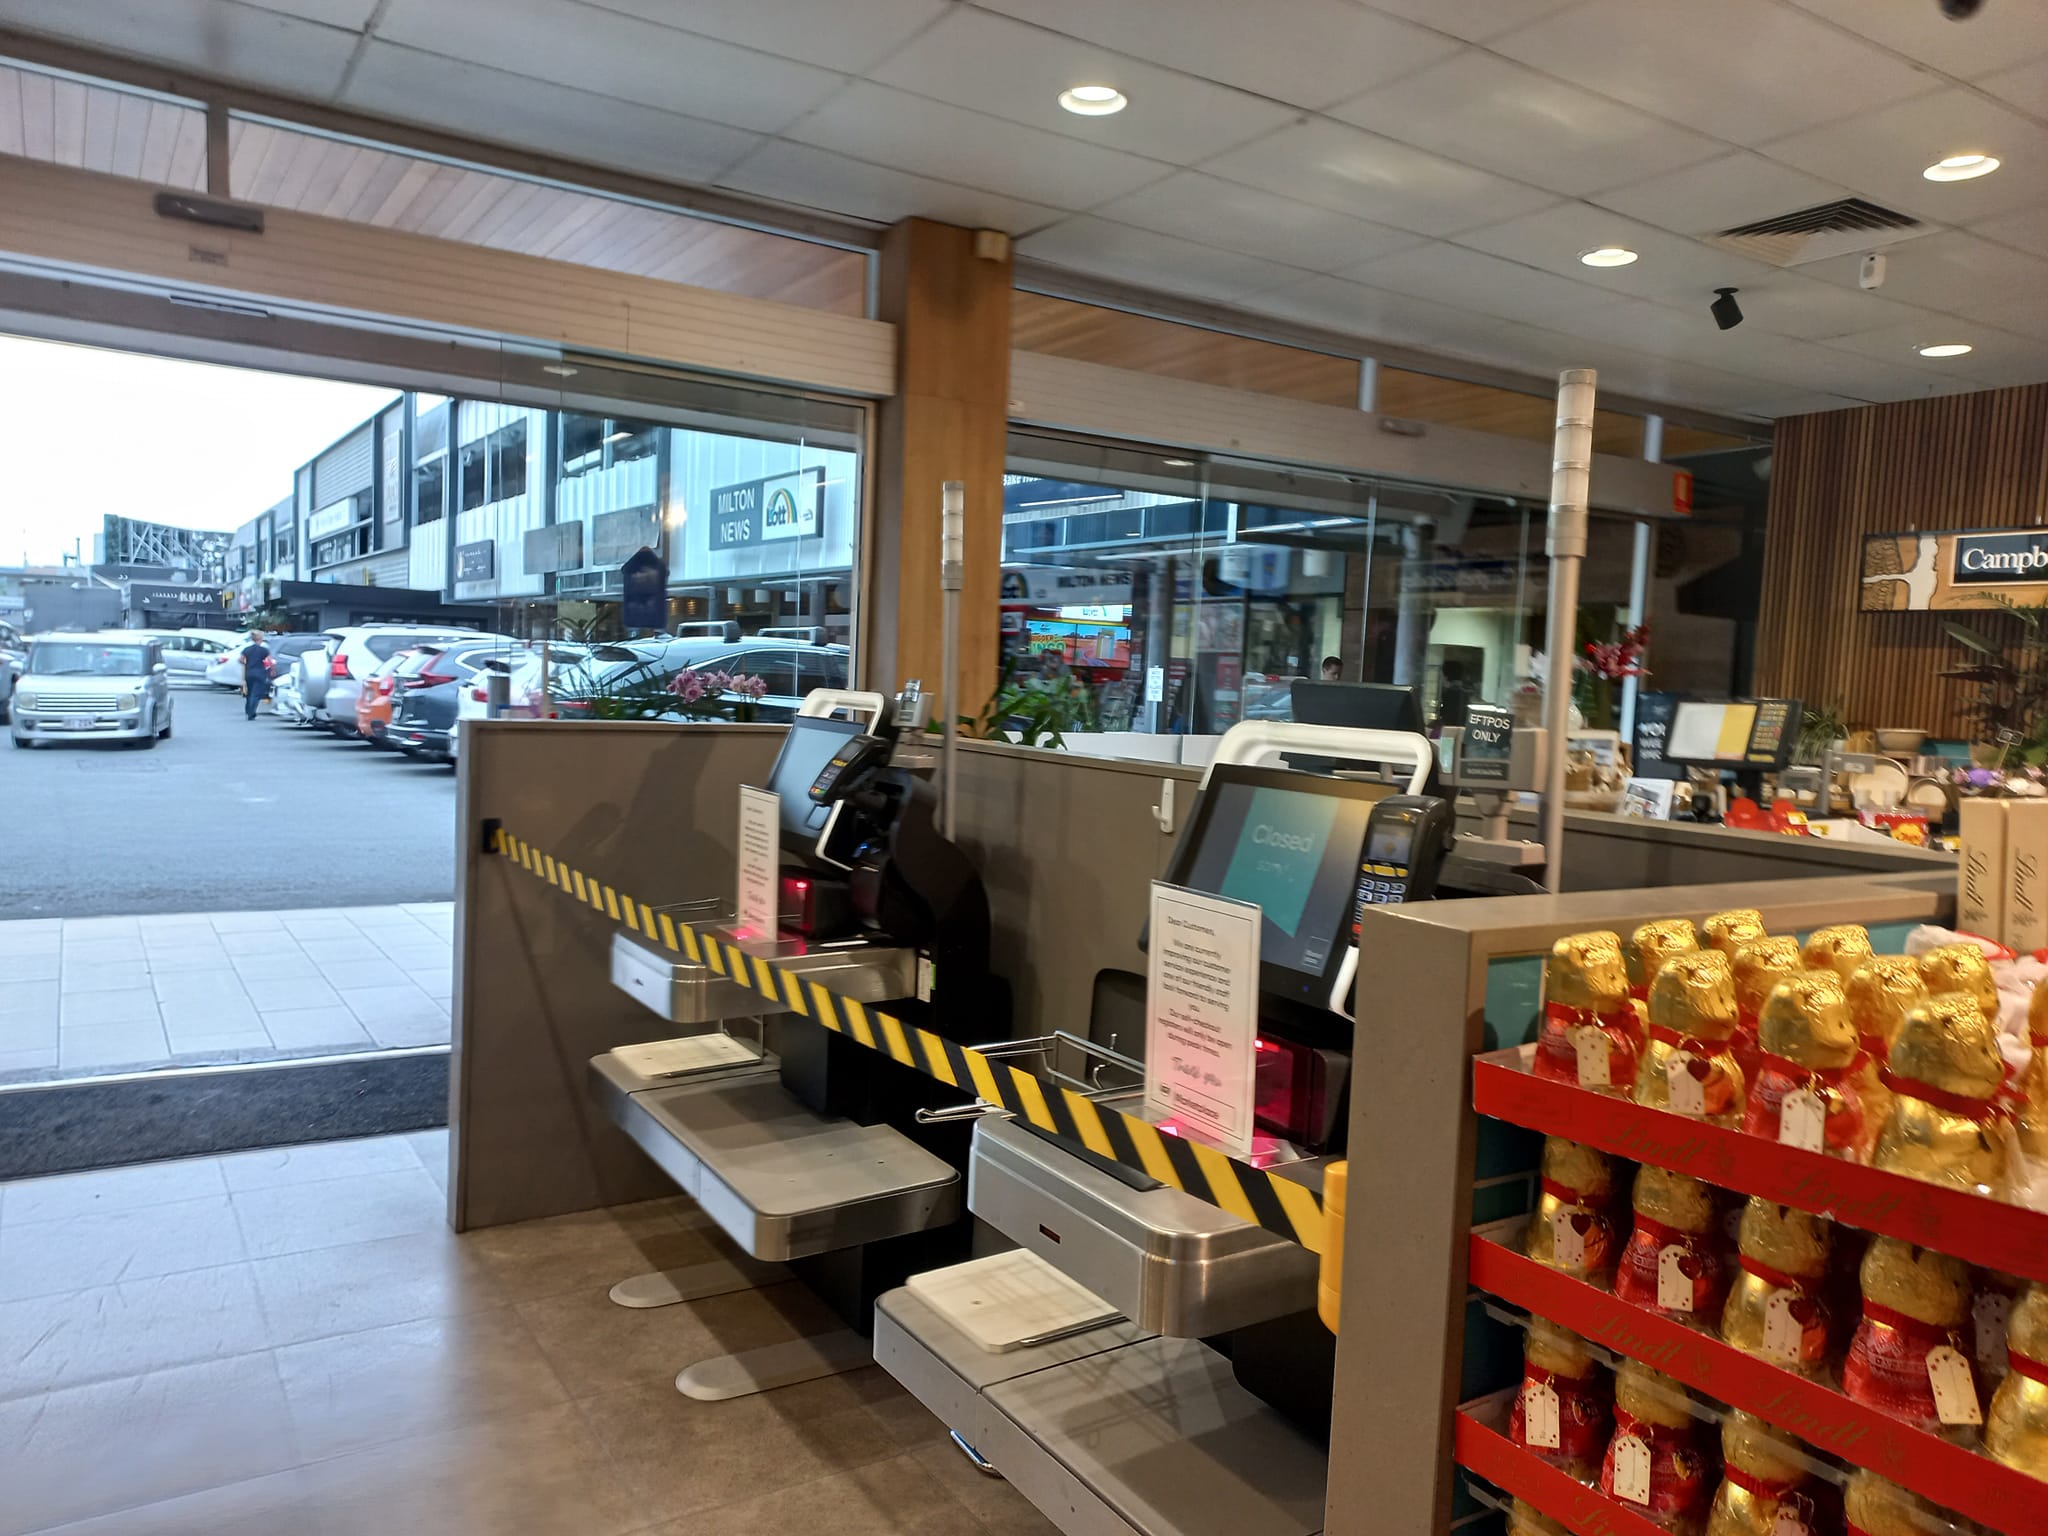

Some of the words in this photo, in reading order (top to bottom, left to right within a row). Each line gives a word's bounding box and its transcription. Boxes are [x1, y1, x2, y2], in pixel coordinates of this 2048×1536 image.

[718, 487, 755, 515] MILTON
[721, 519, 751, 543] NEWS
[1962, 545, 2048, 575] Campb
[180, 591, 214, 603] KURA
[1469, 713, 1511, 730] EFTPOS
[1472, 729, 1501, 743] ONLY
[1252, 824, 1316, 853] Closed
[1603, 1112, 1707, 1166] Lindt
[1773, 1159, 1903, 1224] Lindt
[1590, 1305, 1687, 1366] Lindt
[1753, 1377, 1873, 1450] Lindt
